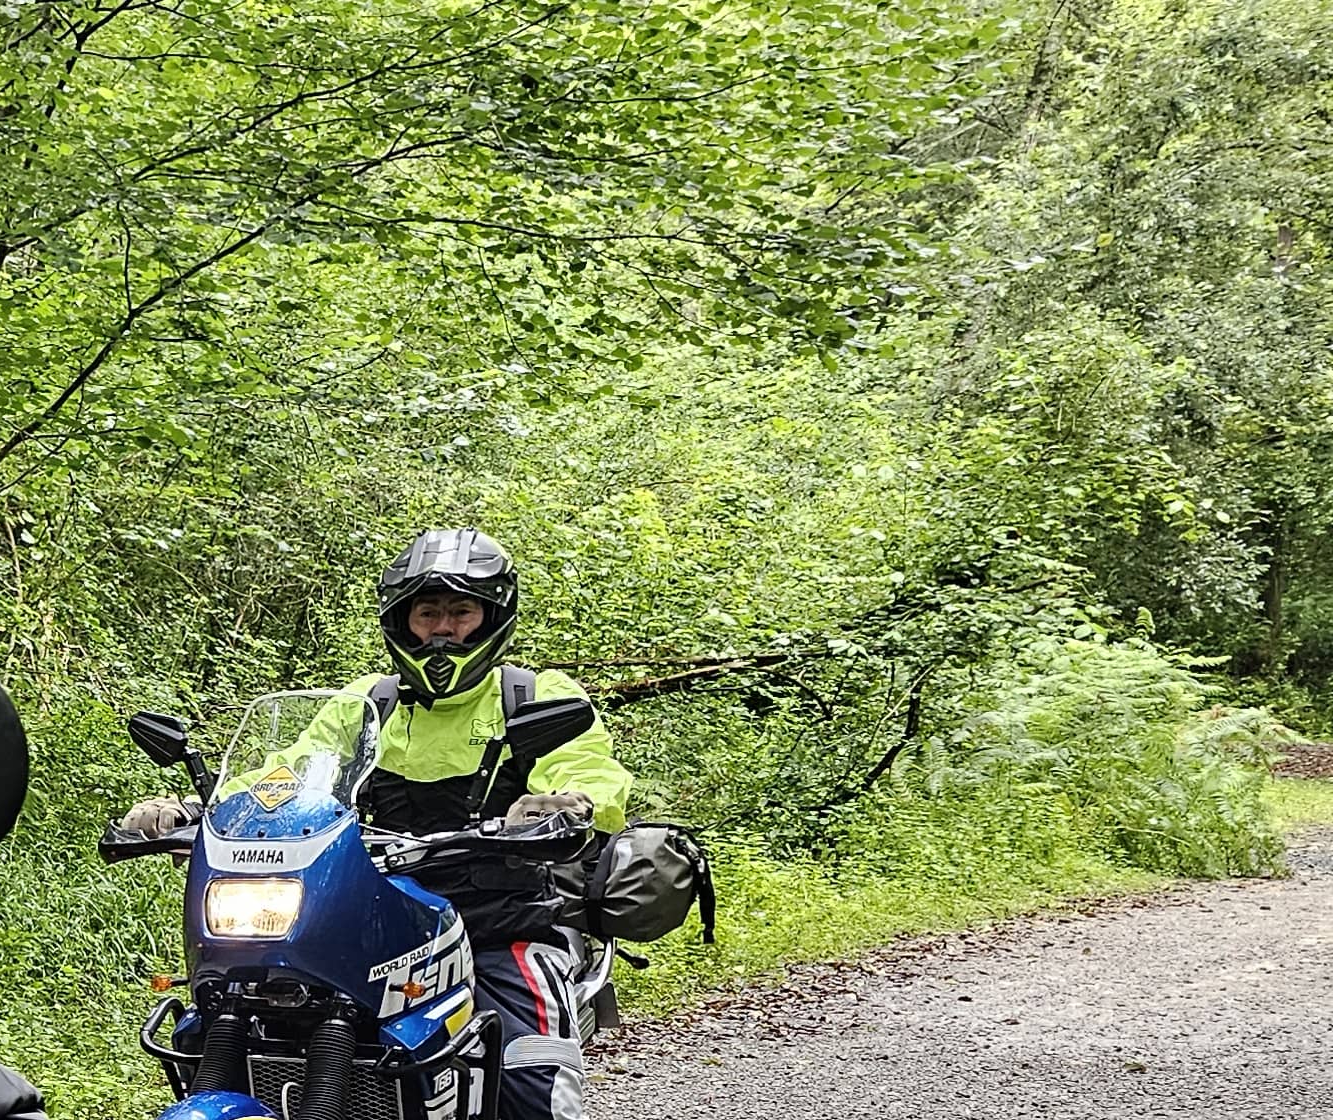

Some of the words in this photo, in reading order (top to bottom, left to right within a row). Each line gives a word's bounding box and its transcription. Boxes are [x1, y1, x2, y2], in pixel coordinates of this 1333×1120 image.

[232, 849, 284, 864] YAMAHA
[372, 955, 408, 978] WORLD
[410, 946, 430, 965] RAID
